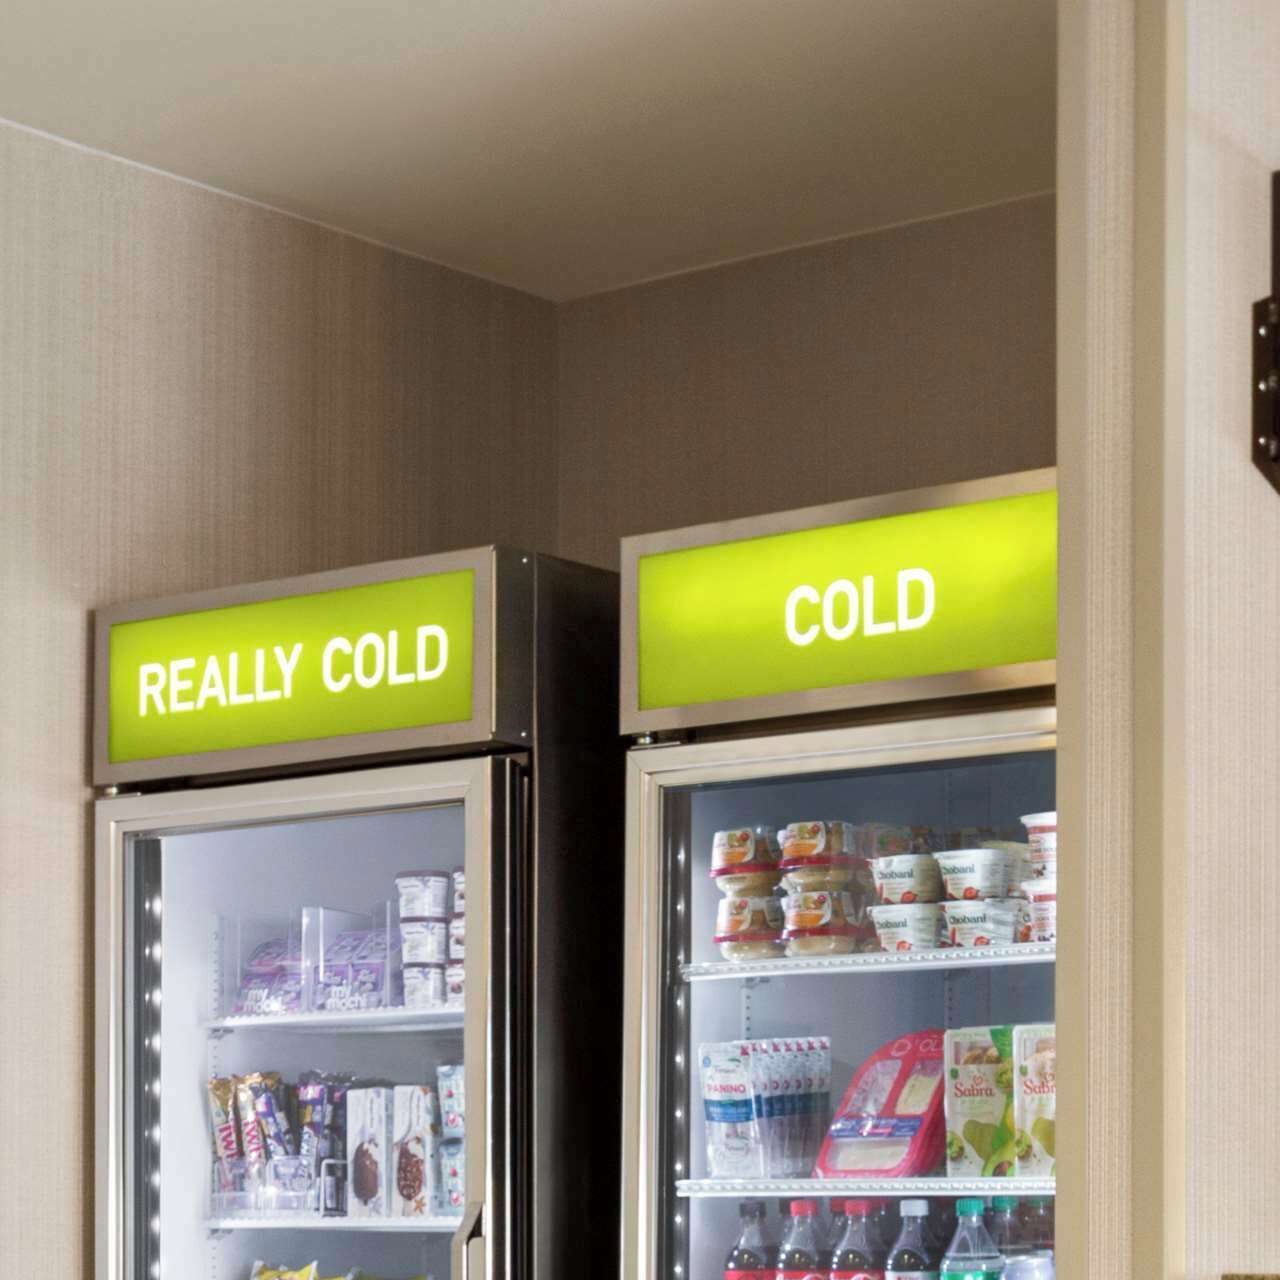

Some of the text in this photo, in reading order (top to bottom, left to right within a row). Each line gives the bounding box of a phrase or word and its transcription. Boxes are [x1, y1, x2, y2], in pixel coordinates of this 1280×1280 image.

[783, 566, 937, 647] COLD
[138, 623, 449, 717] REALLY COLD
[954, 1082, 994, 1099] Sabra
[1023, 1079, 1056, 1096] Sabr
